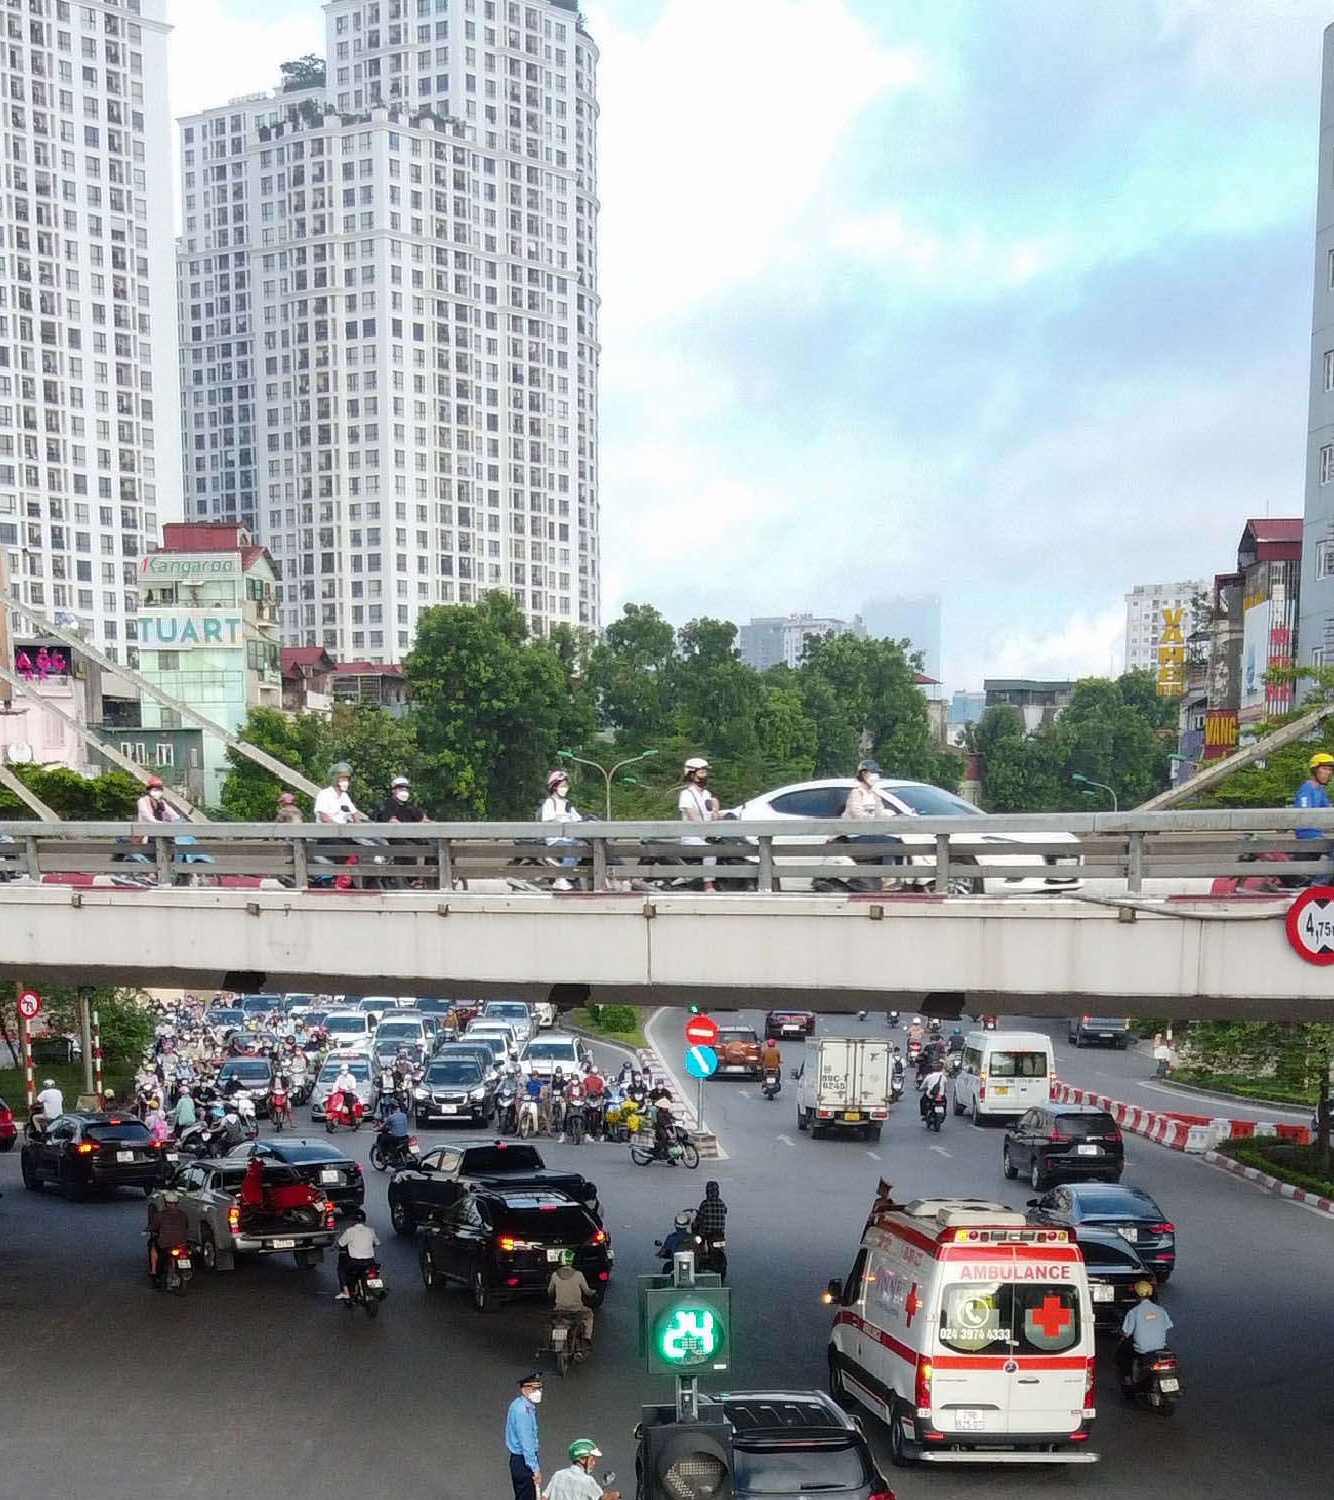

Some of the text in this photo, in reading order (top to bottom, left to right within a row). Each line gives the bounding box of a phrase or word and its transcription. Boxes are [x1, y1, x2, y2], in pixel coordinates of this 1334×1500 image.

[960, 1265, 1071, 1280] AMBULANCE
[940, 1327, 1011, 1340] 024 3974 4333
